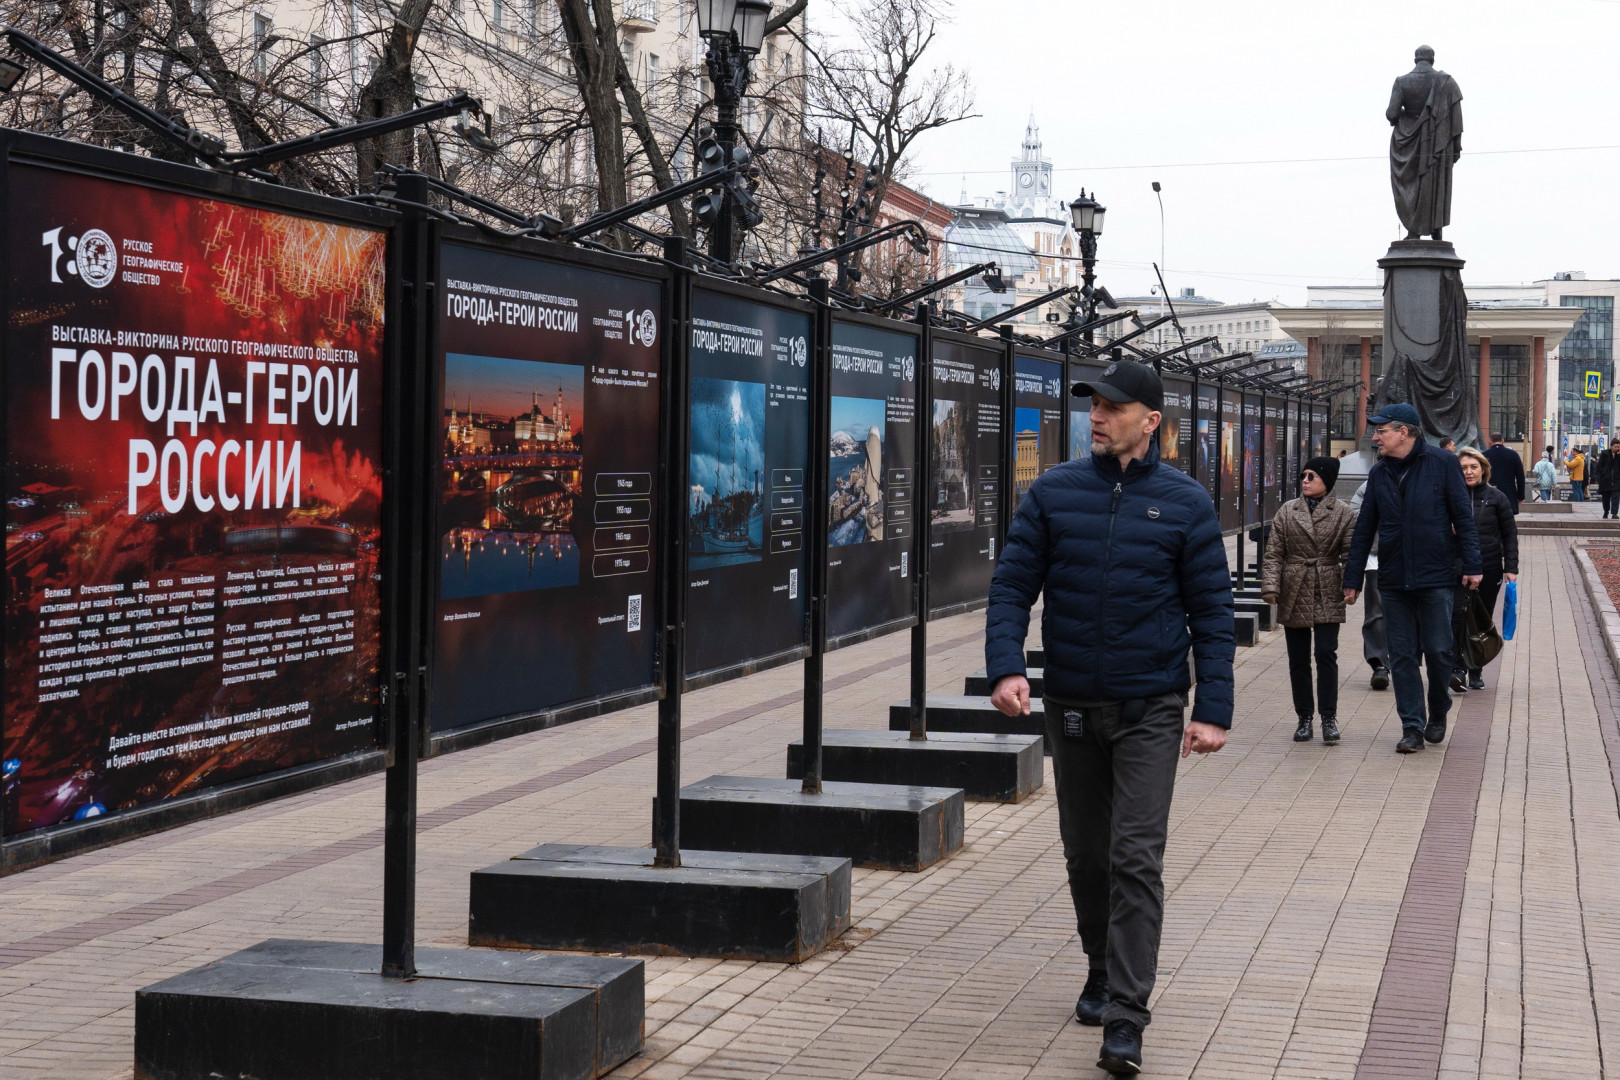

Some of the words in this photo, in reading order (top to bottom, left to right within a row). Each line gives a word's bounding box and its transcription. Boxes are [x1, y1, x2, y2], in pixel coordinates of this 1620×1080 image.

[122, 239, 153, 253] РУССКОЕ
[122, 255, 184, 273] ГЕОГРАФИЧЕСКОЕ
[122, 271, 160, 286] ОБЩЕСТВО
[447, 279, 498, 295] ВЫСТАВКА-ВИКТОРИНА
[499, 287, 519, 298] РУССКОГО
[520, 290, 557, 304] ГЕОГРАФИЧЕСКОГО
[557, 296, 578, 308] ОБЩЕСТВА
[447, 293, 535, 327] ГОРОДА-ГЕРОИ
[538, 306, 578, 332] РОССИИ
[52, 325, 179, 350] ВЫСТАВКА-ВИКТОРИНА
[182, 336, 228, 354] РУССКОГО
[231, 340, 314, 360] ГЕОГРАФИЧЕСКОГО
[316, 348, 359, 364] ОБЩЕСТВА
[692, 329, 740, 354] ГОРОДА-ГЕРОИ
[740, 337, 763, 357] РОССИИ
[832, 354, 866, 373] ГОРОДА-ГЕРОИ
[867, 358, 883, 374] РОССИИ
[51, 347, 358, 436] ГОРОДА-ГЕРОИ
[128, 438, 301, 515] РОССИИ
[227, 571, 255, 581] Ленинград,
[317, 563, 334, 571] Москва
[340, 562, 355, 571] другие
[303, 578, 312, 586] под
[40, 602, 78, 613] испытанием
[80, 601, 91, 610] для
[93, 597, 112, 607] нашей
[114, 597, 136, 607] страны.
[138, 593, 143, 603] В
[144, 593, 168, 604] суровых
[169, 590, 195, 601] условиях,
[196, 588, 215, 597] голоде
[44, 588, 71, 598] Великая
[80, 584, 124, 595] Отечественная
[132, 580, 150, 590] война
[157, 578, 173, 587] стала
[40, 620, 45, 628] и
[49, 616, 82, 627] лишениях,
[86, 614, 104, 623] когда
[108, 611, 122, 622] враг
[126, 608, 153, 619] наступал,
[168, 604, 188, 614] защиту
[191, 601, 214, 610] Отчизны
[226, 624, 246, 634] Русское
[254, 618, 292, 629] географическое
[299, 614, 320, 623] общество
[39, 632, 73, 643] поднялись
[78, 628, 101, 639] города,
[106, 625, 131, 634] ставшие
[135, 619, 179, 632] неприступными
[183, 615, 214, 625] бастионами
[39, 650, 44, 658] и
[45, 646, 76, 658] центрами
[77, 641, 100, 654] борьбы
[110, 637, 134, 648] свободу
[135, 637, 140, 645] и
[184, 629, 196, 638] Они
[197, 628, 214, 636] вошли
[222, 649, 246, 659] позволит
[249, 646, 269, 655] оценить
[39, 665, 43, 673] в
[44, 661, 70, 672] историю
[71, 660, 82, 668] как
[83, 654, 122, 667] города-герои
[127, 650, 152, 660] символы
[153, 645, 181, 656] стойкости
[204, 641, 214, 649] где
[222, 658, 259, 672] Отечественной
[261, 656, 277, 666] войны
[39, 677, 63, 687] каждая
[64, 674, 83, 686] улица
[85, 669, 116, 682] пропитана
[118, 666, 136, 677] духом
[137, 660, 179, 673] сопротивления
[181, 654, 214, 667] фашистским
[222, 675, 245, 686] прошлом
[39, 689, 80, 702] захватчикам.
[108, 732, 140, 752] Давайте
[142, 729, 168, 743] вместе
[169, 721, 204, 737] вспомним
[204, 716, 232, 730] подвиги
[233, 708, 261, 724] жителей
[262, 701, 309, 719] городов-героев
[106, 759, 112, 769] и
[113, 754, 136, 769] будем
[138, 745, 174, 763] гордиться
[175, 743, 189, 754] тем
[189, 734, 228, 751] наследием,
[229, 729, 255, 742] которое
[256, 726, 268, 737] они
[269, 723, 280, 733] нам
[281, 714, 311, 730] оставили!
